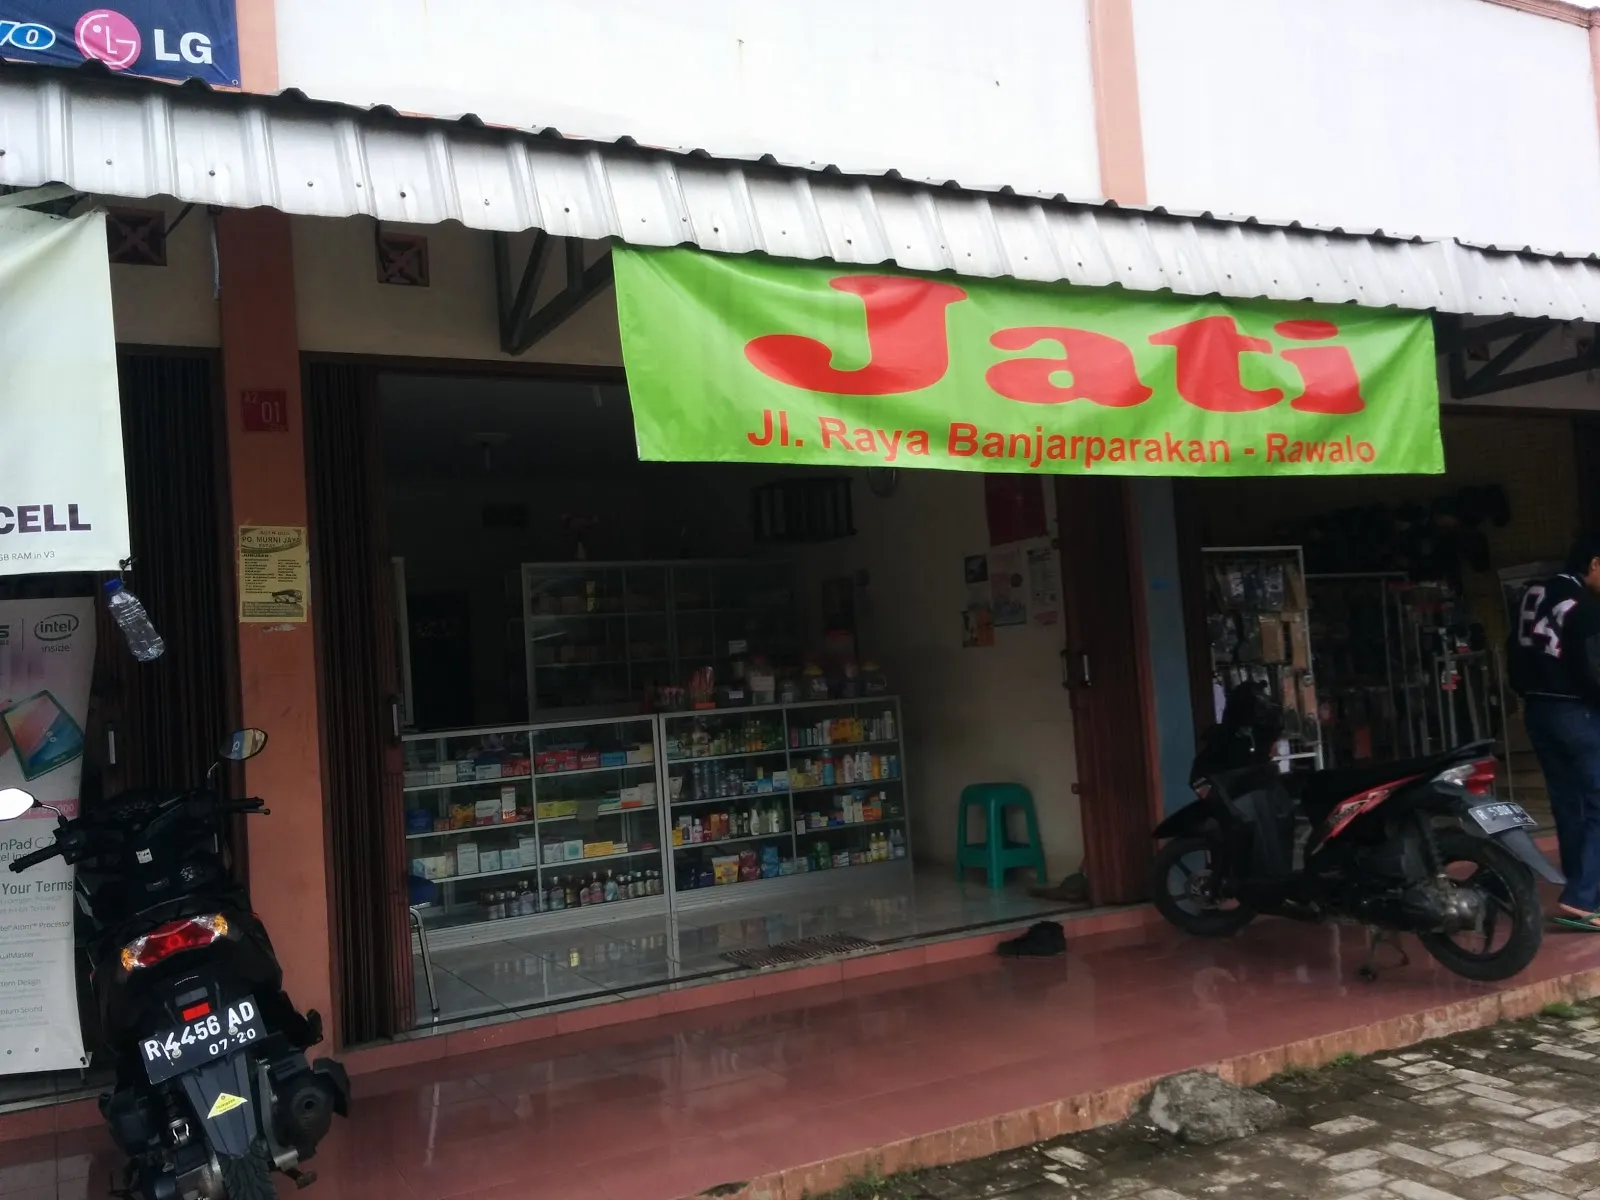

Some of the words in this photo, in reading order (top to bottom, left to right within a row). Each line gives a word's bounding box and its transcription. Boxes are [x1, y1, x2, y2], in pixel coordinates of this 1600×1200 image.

[154, 28, 212, 65] LG
[744, 273, 1366, 415] Jati
[748, 409, 802, 448] Jl.
[822, 416, 929, 462] Raya
[947, 422, 1227, 469] Banjarparakan
[1266, 431, 1376, 464] Rawalo
[0, 503, 92, 535] CELL
[11, 552, 32, 560] RAM
[43, 550, 55, 559] V3
[40, 620, 71, 633] intel
[41, 643, 70, 653] inside
[2, 883, 31, 895] Your
[35, 880, 73, 893] Terms
[39, 921, 70, 929] Processor
[17, 978, 41, 987] Design
[20, 1005, 43, 1014] Sound
[144, 1039, 161, 1061] R
[164, 1015, 220, 1051] 4456
[228, 1001, 255, 1030] AD
